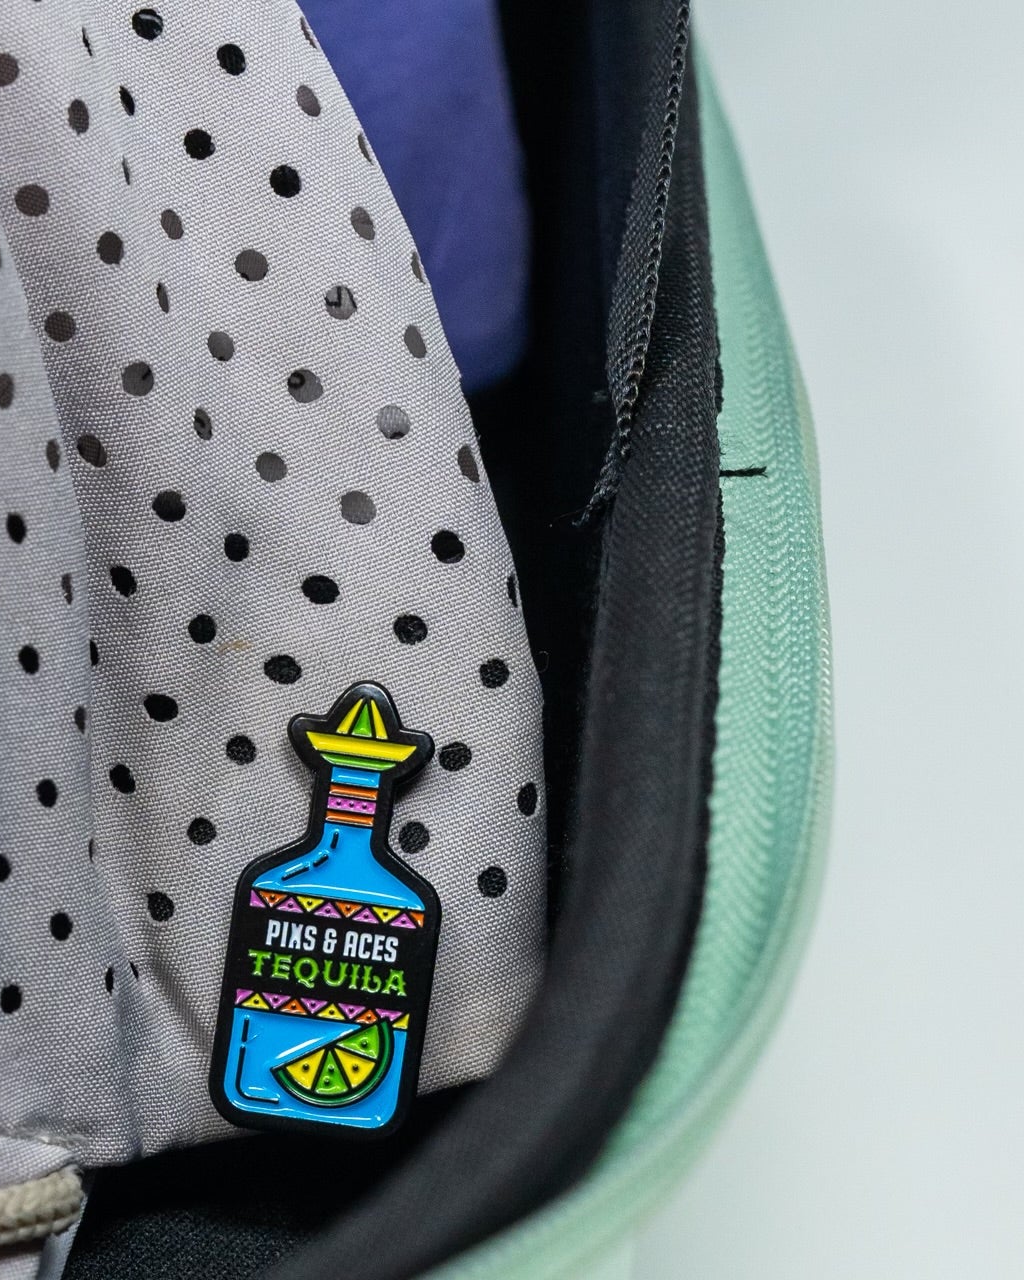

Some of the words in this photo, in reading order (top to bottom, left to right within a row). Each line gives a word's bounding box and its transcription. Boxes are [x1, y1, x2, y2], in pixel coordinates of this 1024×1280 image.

[322, 928, 337, 954] &
[343, 931, 399, 963] ACES
[248, 949, 407, 997] TEQUILA
